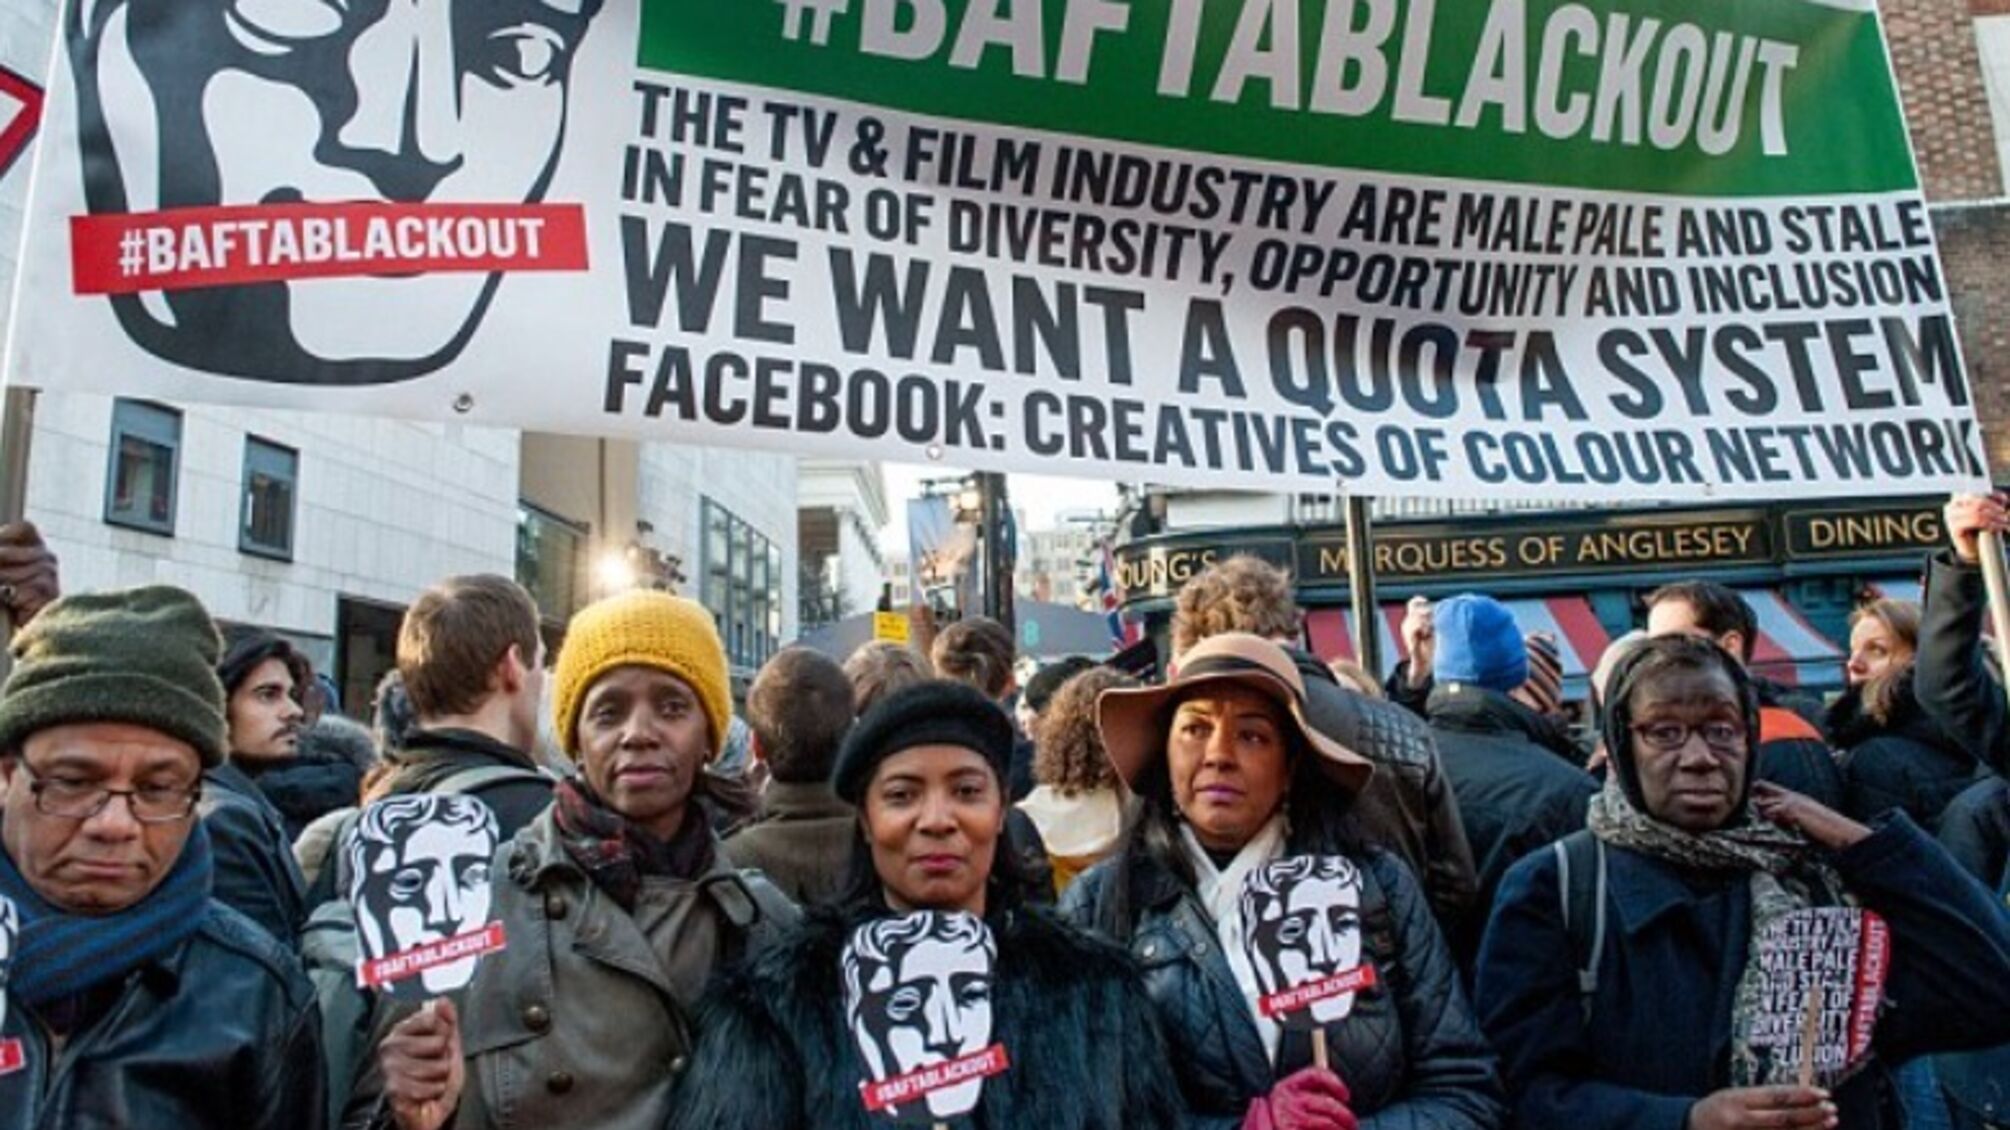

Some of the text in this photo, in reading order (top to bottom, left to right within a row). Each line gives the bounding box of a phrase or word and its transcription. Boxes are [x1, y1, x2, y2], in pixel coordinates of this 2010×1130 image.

[620, 145, 1942, 318] IN FEAR OF DIVERSITY, OPPORTUNITY AND INCLUSION
[633, 80, 1933, 258] THE TV & FILM INDUSTRY ARE MALE PALE AND STALE
[118, 217, 546, 276] #BAFTABLACKOUT
[620, 214, 1970, 422] WE WANT A QUOTA SYSTEM
[604, 339, 1983, 484] FACEBOOK: CREATIVES OF COLOUR NETWORK
[1319, 525, 1754, 574] MRQUESS OF ANGLESEY
[1810, 512, 1940, 548] DINING
